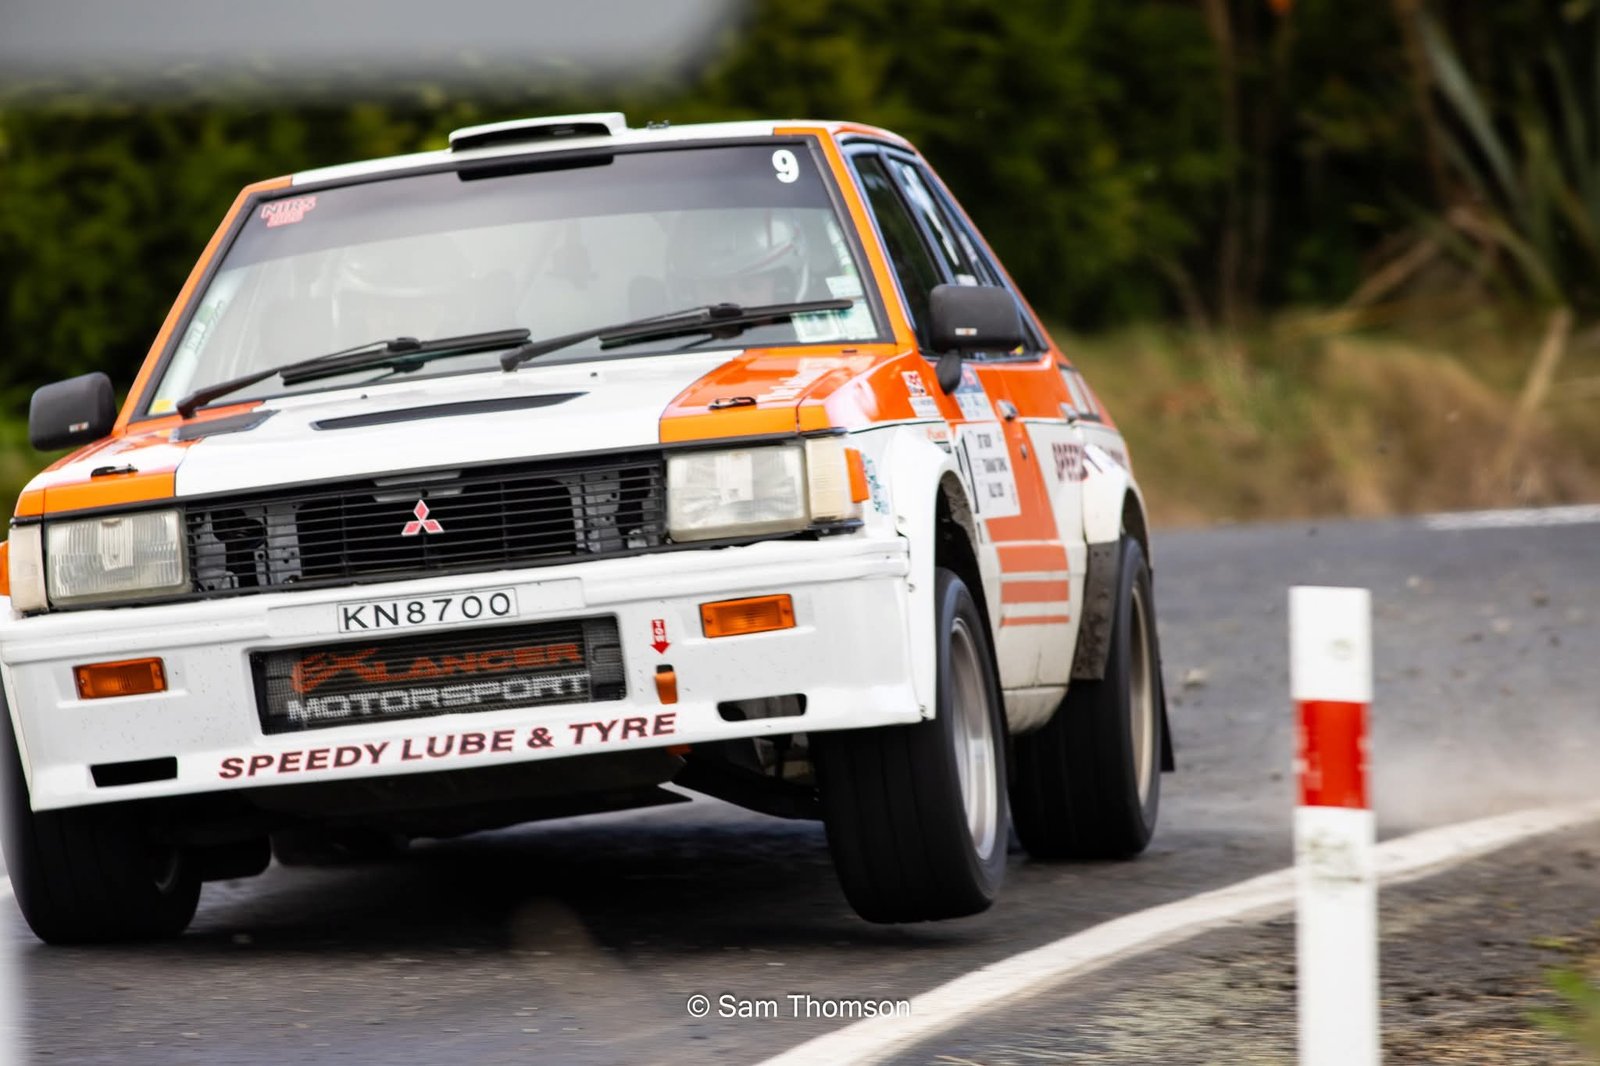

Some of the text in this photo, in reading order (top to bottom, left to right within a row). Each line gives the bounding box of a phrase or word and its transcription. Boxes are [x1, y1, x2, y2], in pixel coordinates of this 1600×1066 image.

[772, 149, 799, 183] 9
[343, 592, 510, 631] KN8700
[287, 670, 591, 721] MOTORSPORT
[219, 713, 677, 779] SPEEDY LUBE & TYRE
